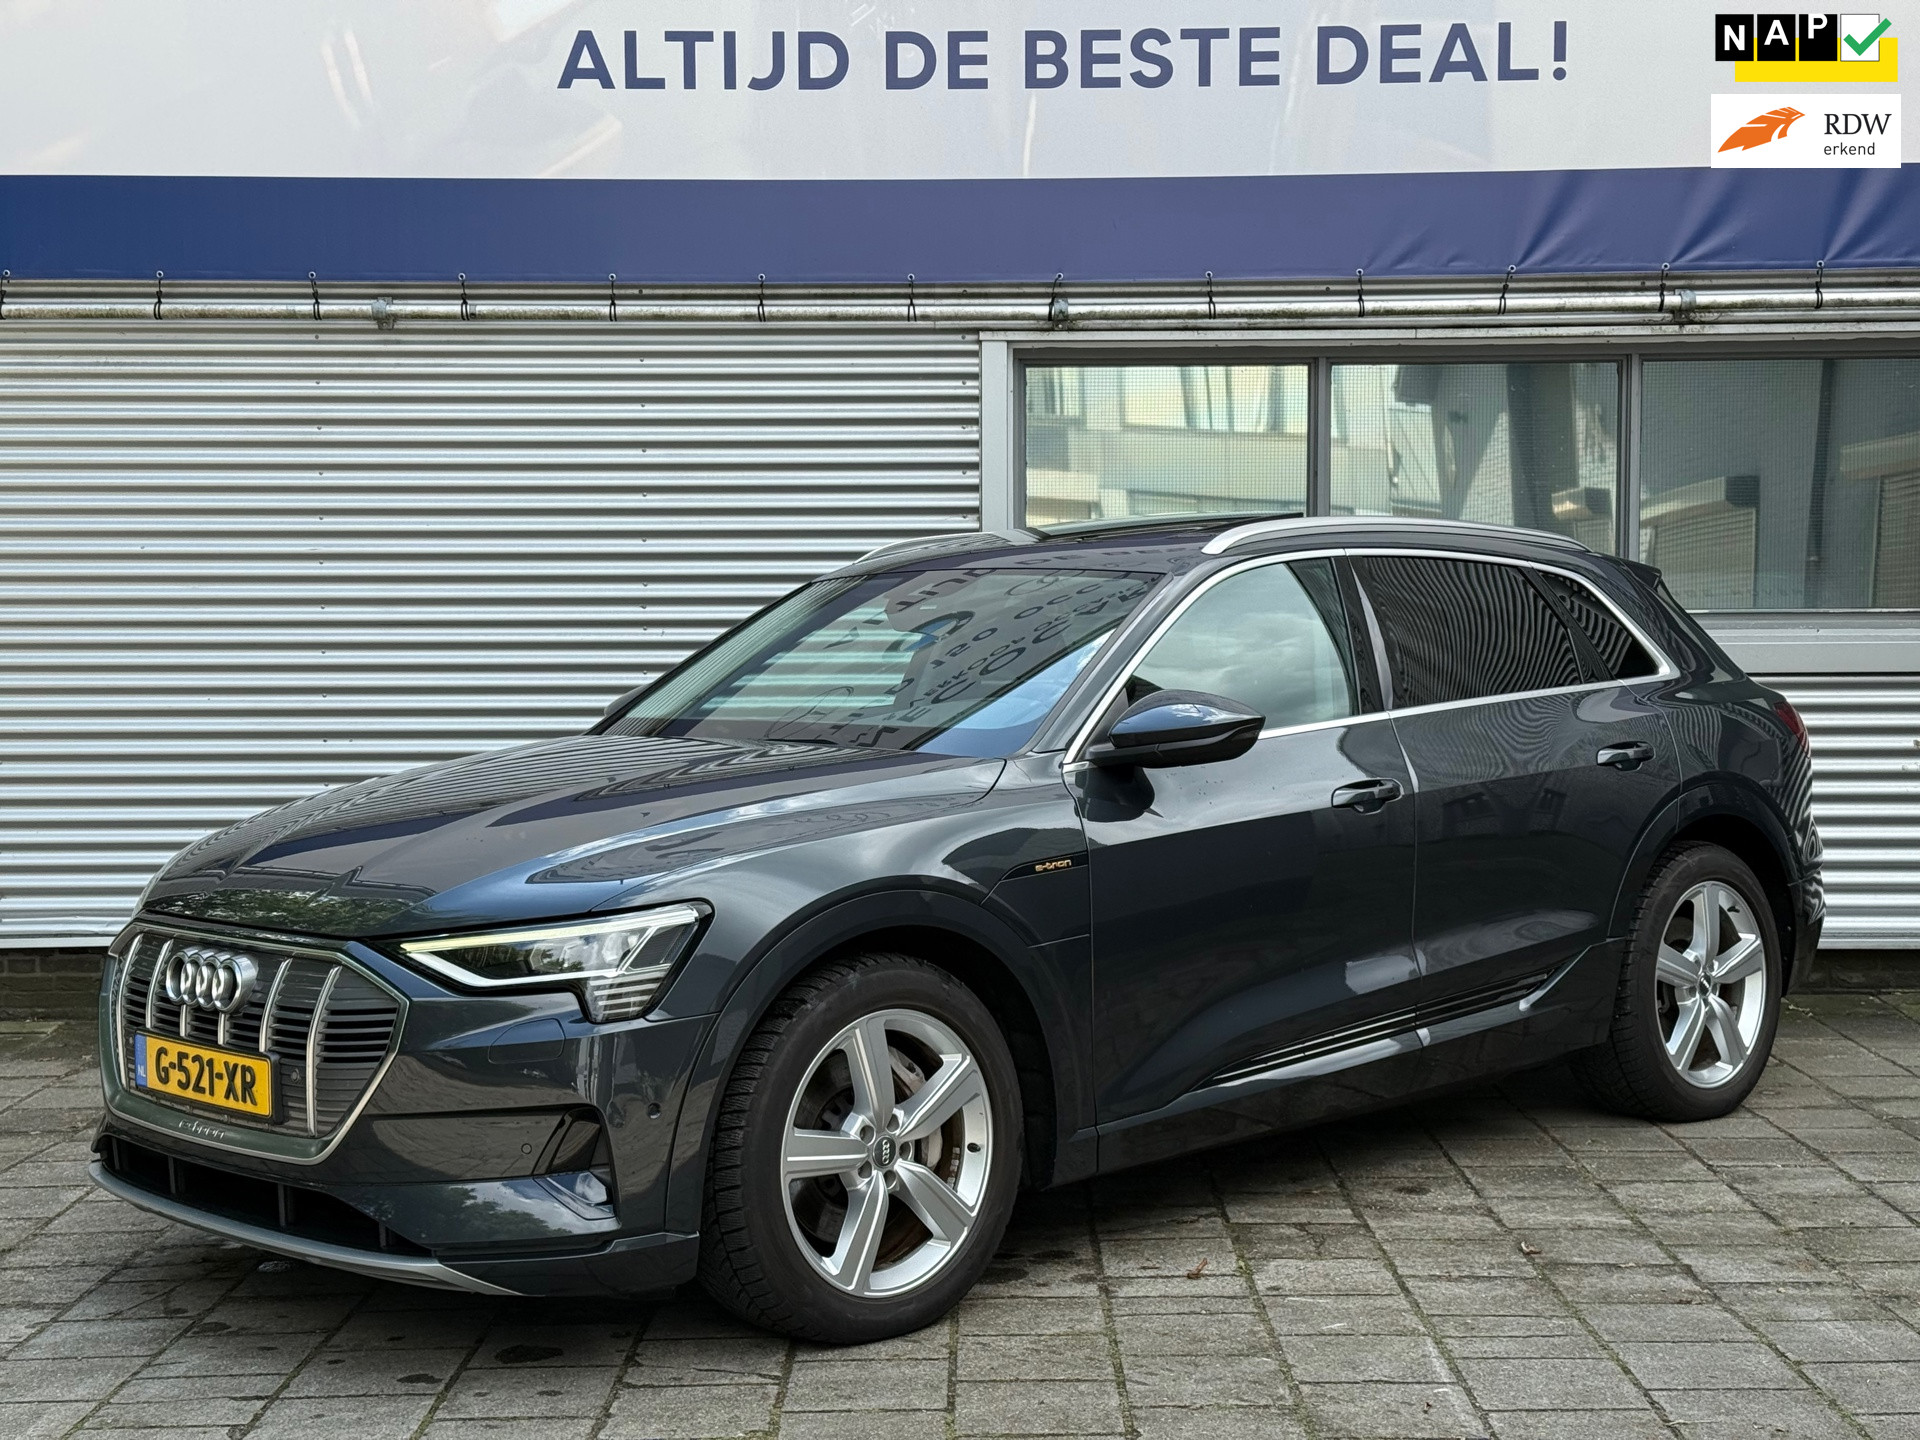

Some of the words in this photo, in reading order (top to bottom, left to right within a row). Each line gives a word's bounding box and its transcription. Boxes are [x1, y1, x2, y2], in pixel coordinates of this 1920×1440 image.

[556, 29, 850, 91] ALTIJD
[885, 30, 989, 91] DE
[1024, 26, 1281, 90] BESTE
[1316, 20, 1568, 86] DEAL!
[154, 1046, 258, 1107] G-521-XR
